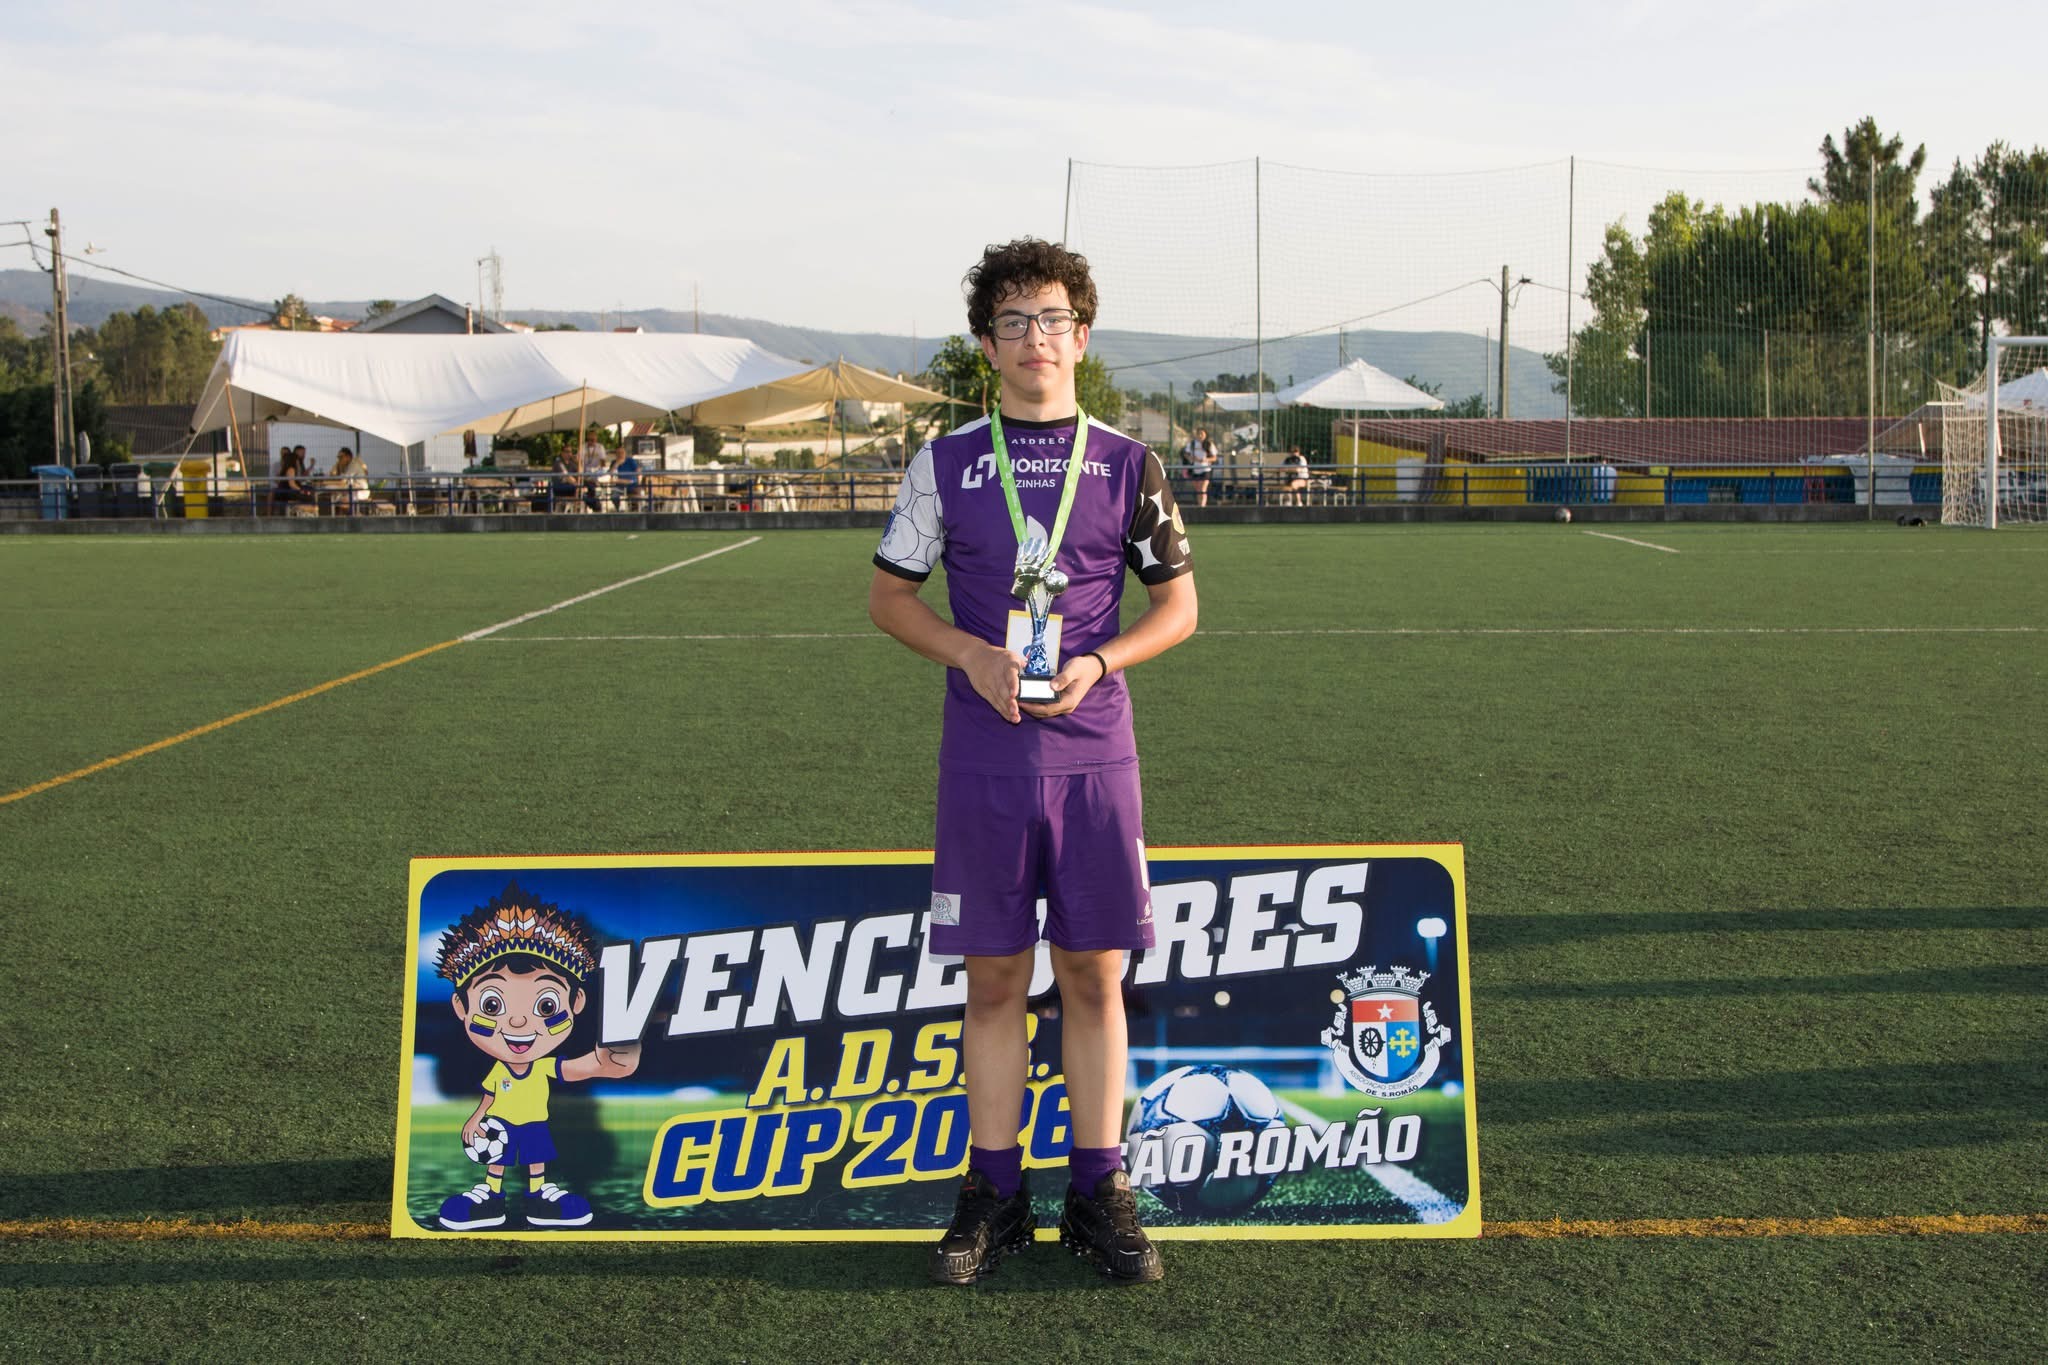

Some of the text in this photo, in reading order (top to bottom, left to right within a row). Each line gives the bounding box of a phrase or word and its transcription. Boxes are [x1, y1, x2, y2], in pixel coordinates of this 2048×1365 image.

[1000, 479, 1056, 489] ZINHAS
[599, 862, 1369, 1044] VENCERES
[748, 1012, 1050, 1107] A.D.S..
[1365, 1088, 1377, 1096] DE
[647, 1103, 847, 1204] CUP
[1121, 1106, 1422, 1187] ÃO ROMÃO
